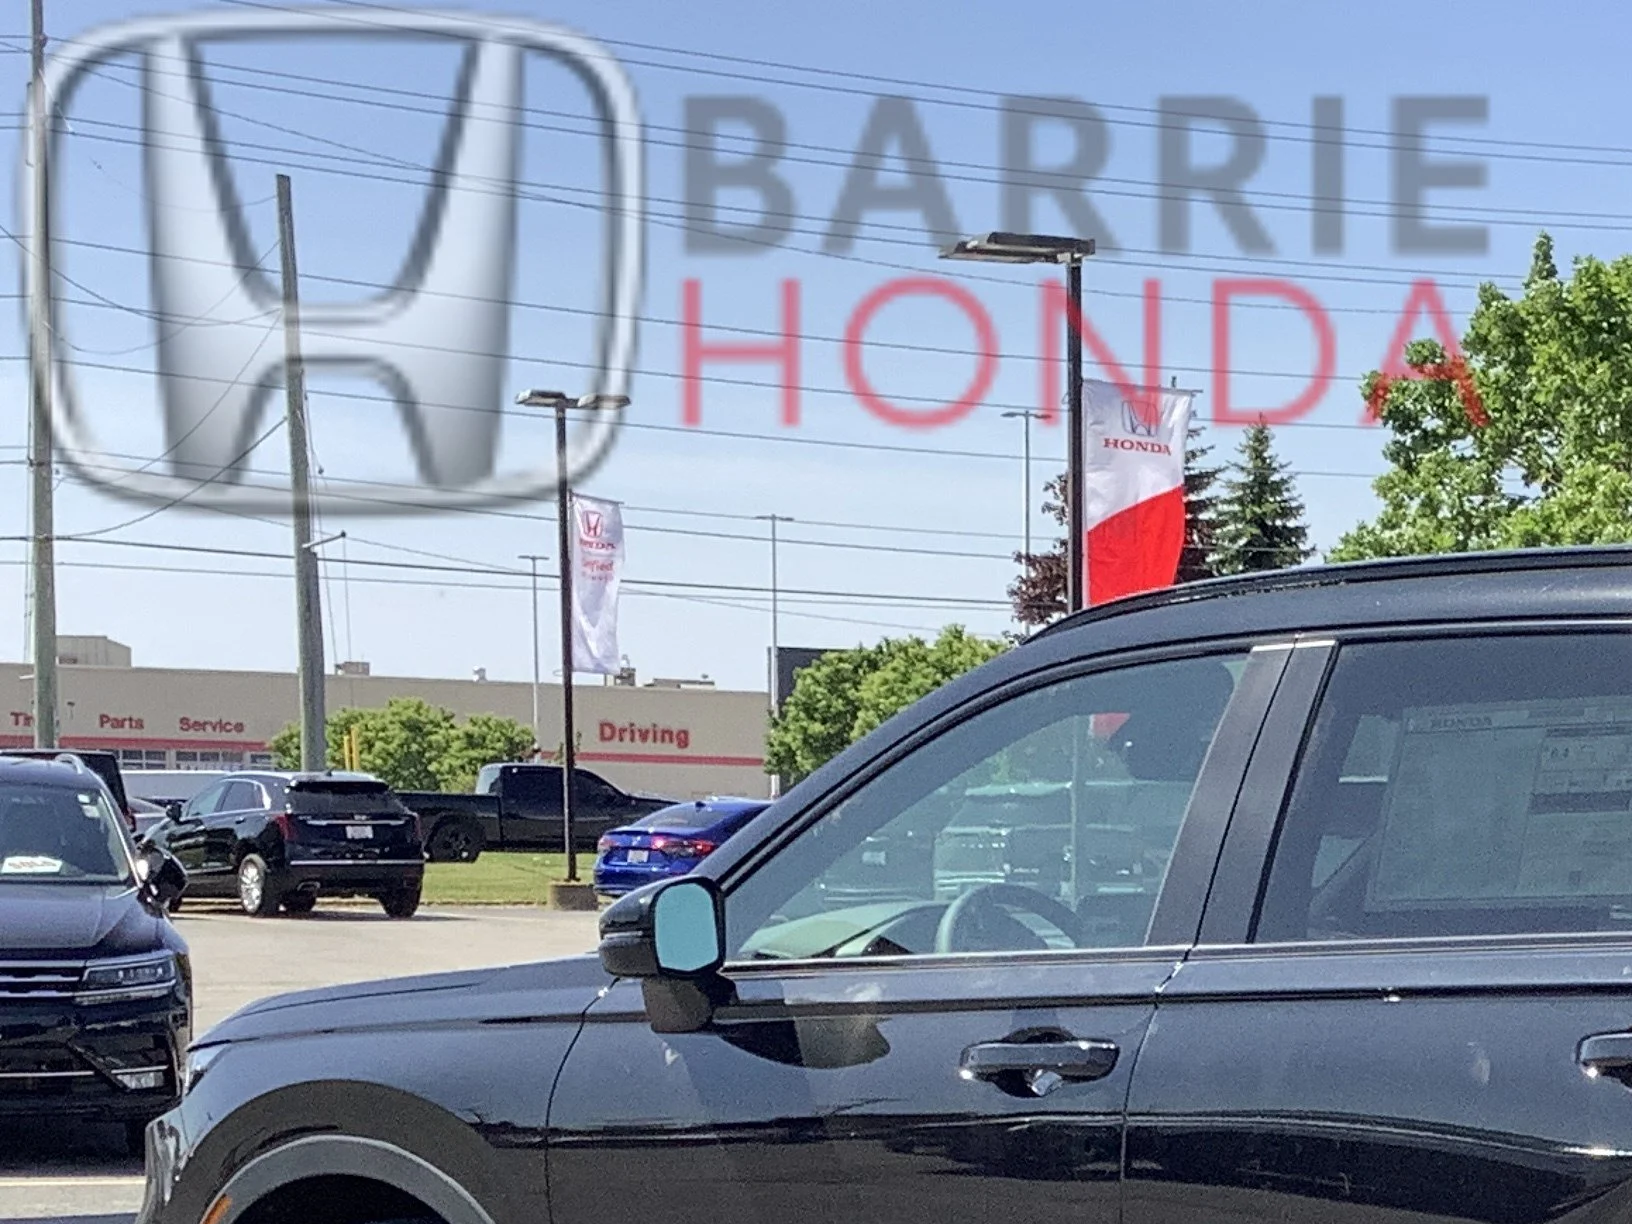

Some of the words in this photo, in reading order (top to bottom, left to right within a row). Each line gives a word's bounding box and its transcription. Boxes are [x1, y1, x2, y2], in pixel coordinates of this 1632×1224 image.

[1103, 438, 1172, 456] HONDA
[99, 714, 145, 730] Parts
[179, 717, 245, 733] Service
[599, 721, 690, 749] Driving
